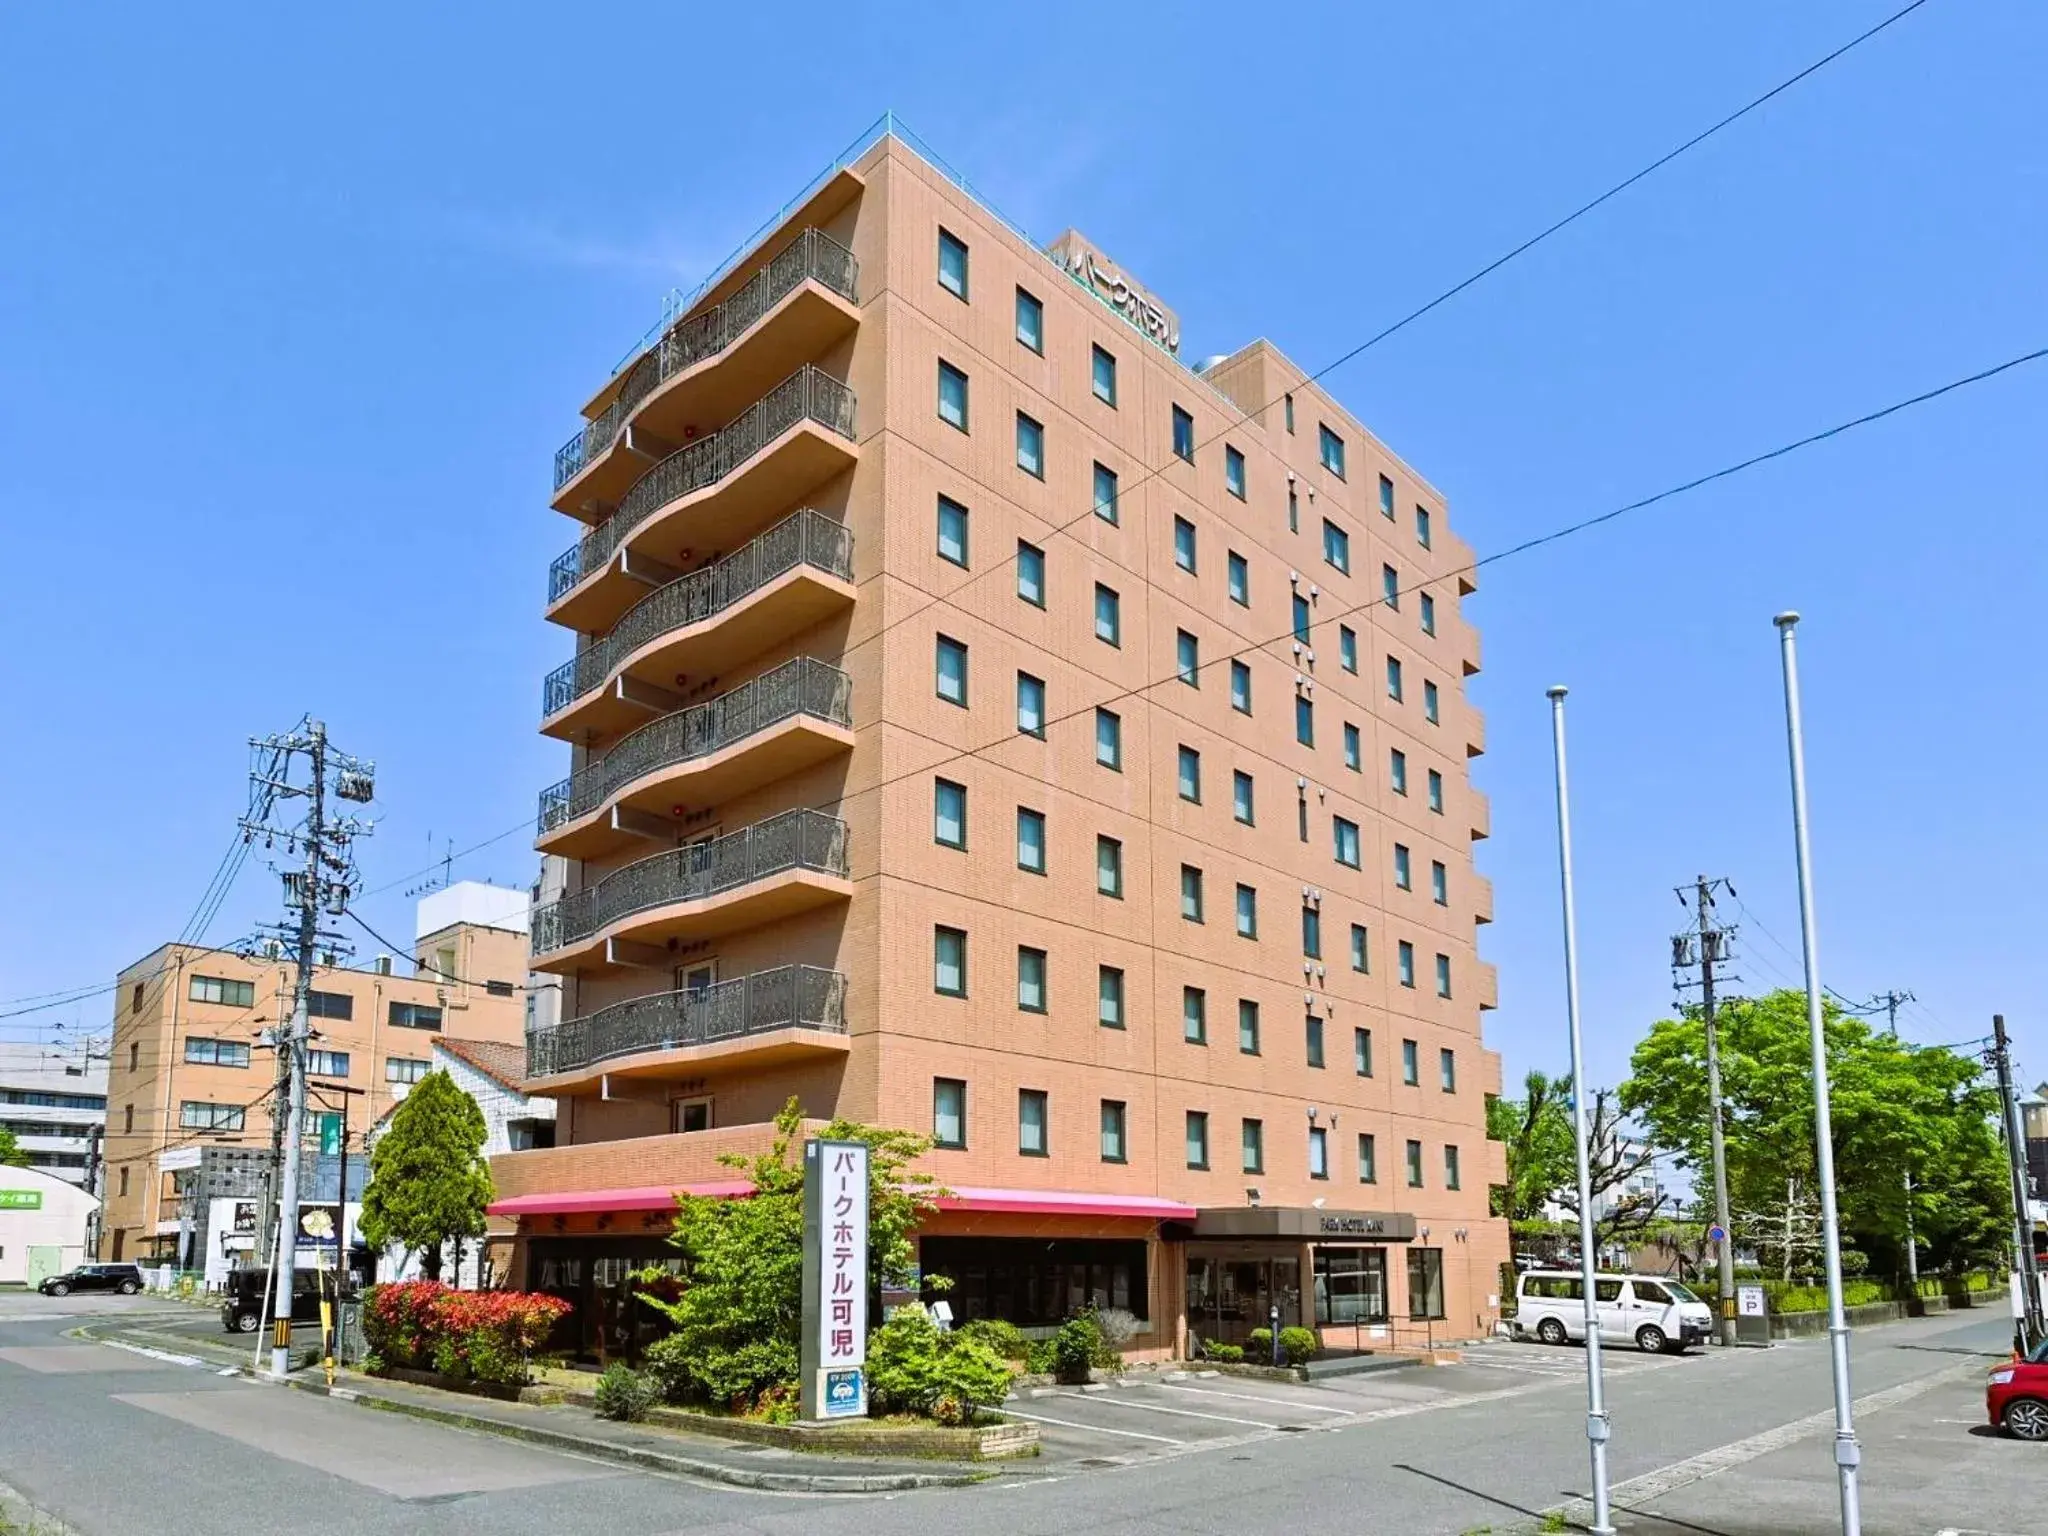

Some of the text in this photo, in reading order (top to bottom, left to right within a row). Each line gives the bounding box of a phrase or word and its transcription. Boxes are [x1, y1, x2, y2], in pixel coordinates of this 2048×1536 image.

[832, 1152, 855, 1357] パークホテル可児
[1746, 1301, 1757, 1312] P
